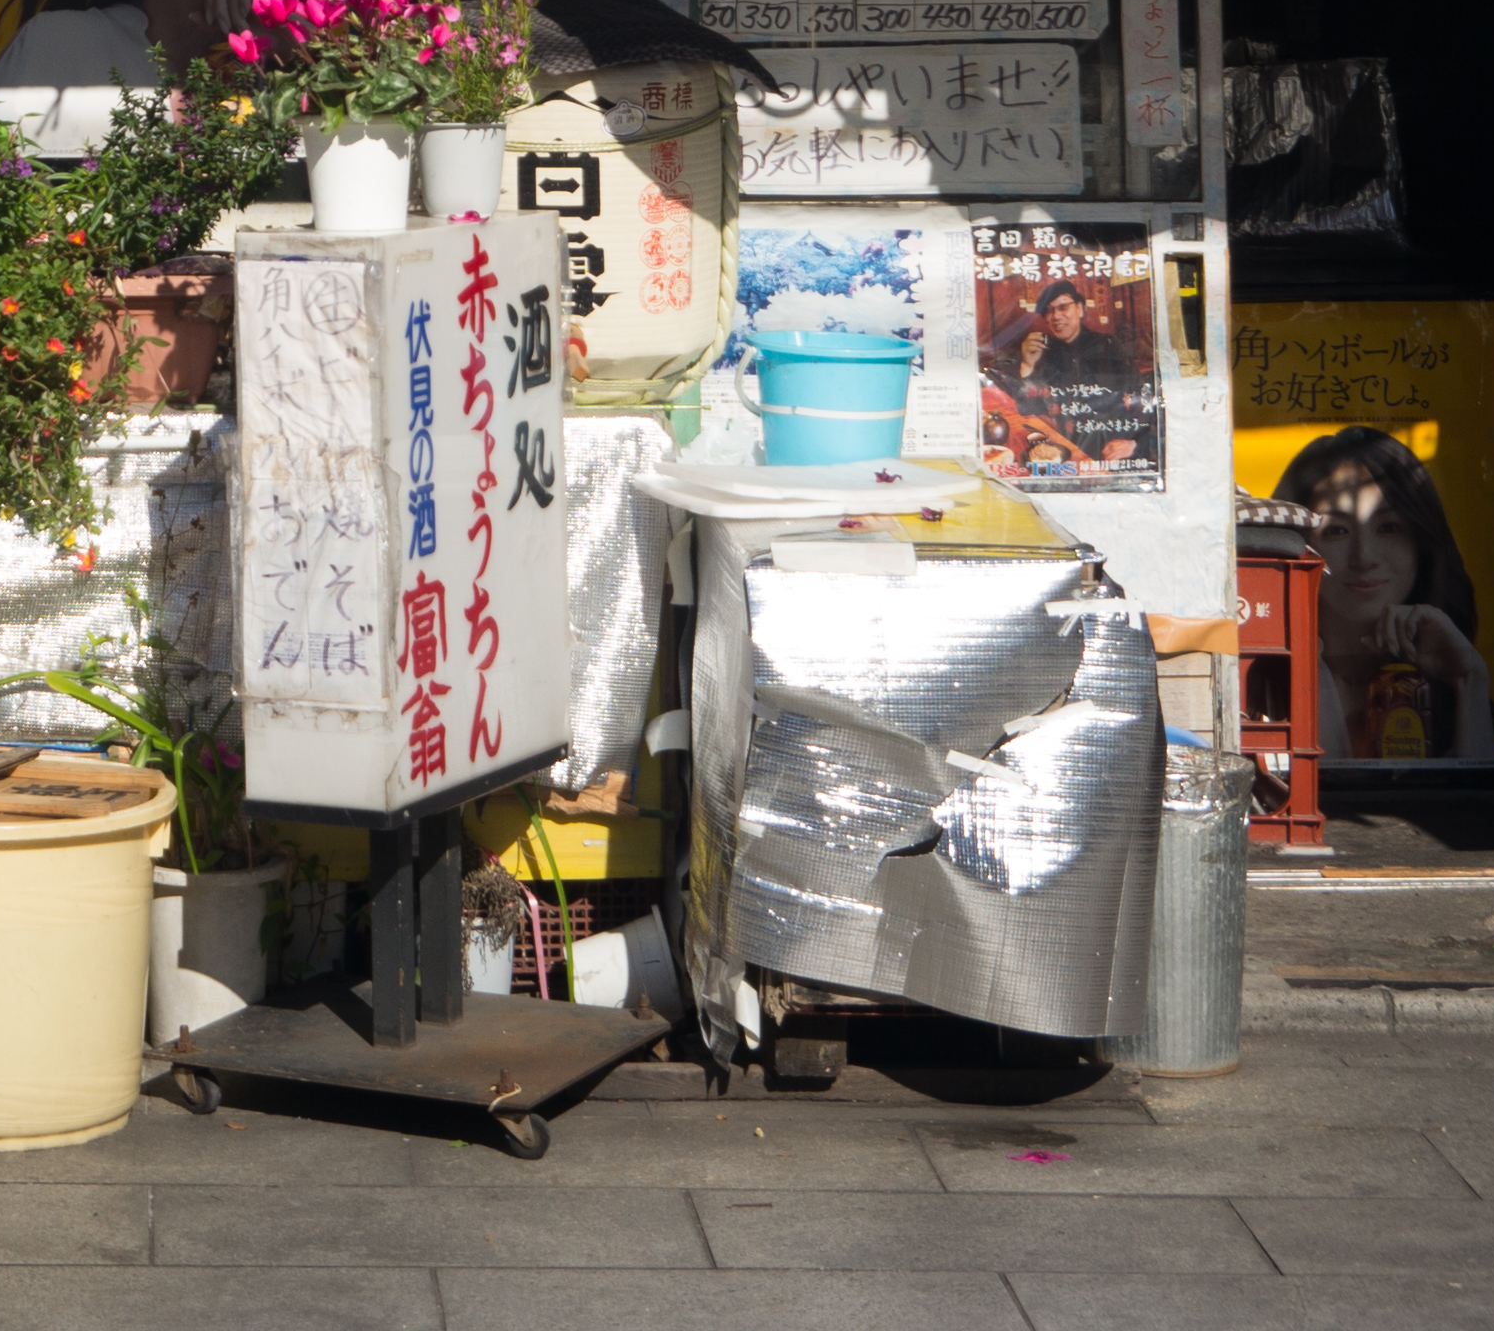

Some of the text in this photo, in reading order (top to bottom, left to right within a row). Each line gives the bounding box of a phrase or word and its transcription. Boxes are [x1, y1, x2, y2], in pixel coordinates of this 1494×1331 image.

[703, 6, 734, 28] 50
[740, 6, 791, 29] 350
[809, 5, 854, 31] 550
[862, 8, 910, 30] 300
[922, 6, 971, 30] 450
[979, 6, 1030, 30] 450
[1036, 6, 1086, 30] 500
[641, 81, 693, 112] 商標
[973, 227, 1077, 252] 吉田類の
[975, 251, 1150, 282] 酒場放浪記
[1231, 327, 1450, 371] 角ハイボールが
[1250, 372, 1430, 412] お好きでしょ。
[404, 300, 436, 560] 伏見の酒
[457, 234, 503, 764] 赤ちょうちん
[259, 495, 307, 671] おでん
[397, 571, 451, 788] 富翁
